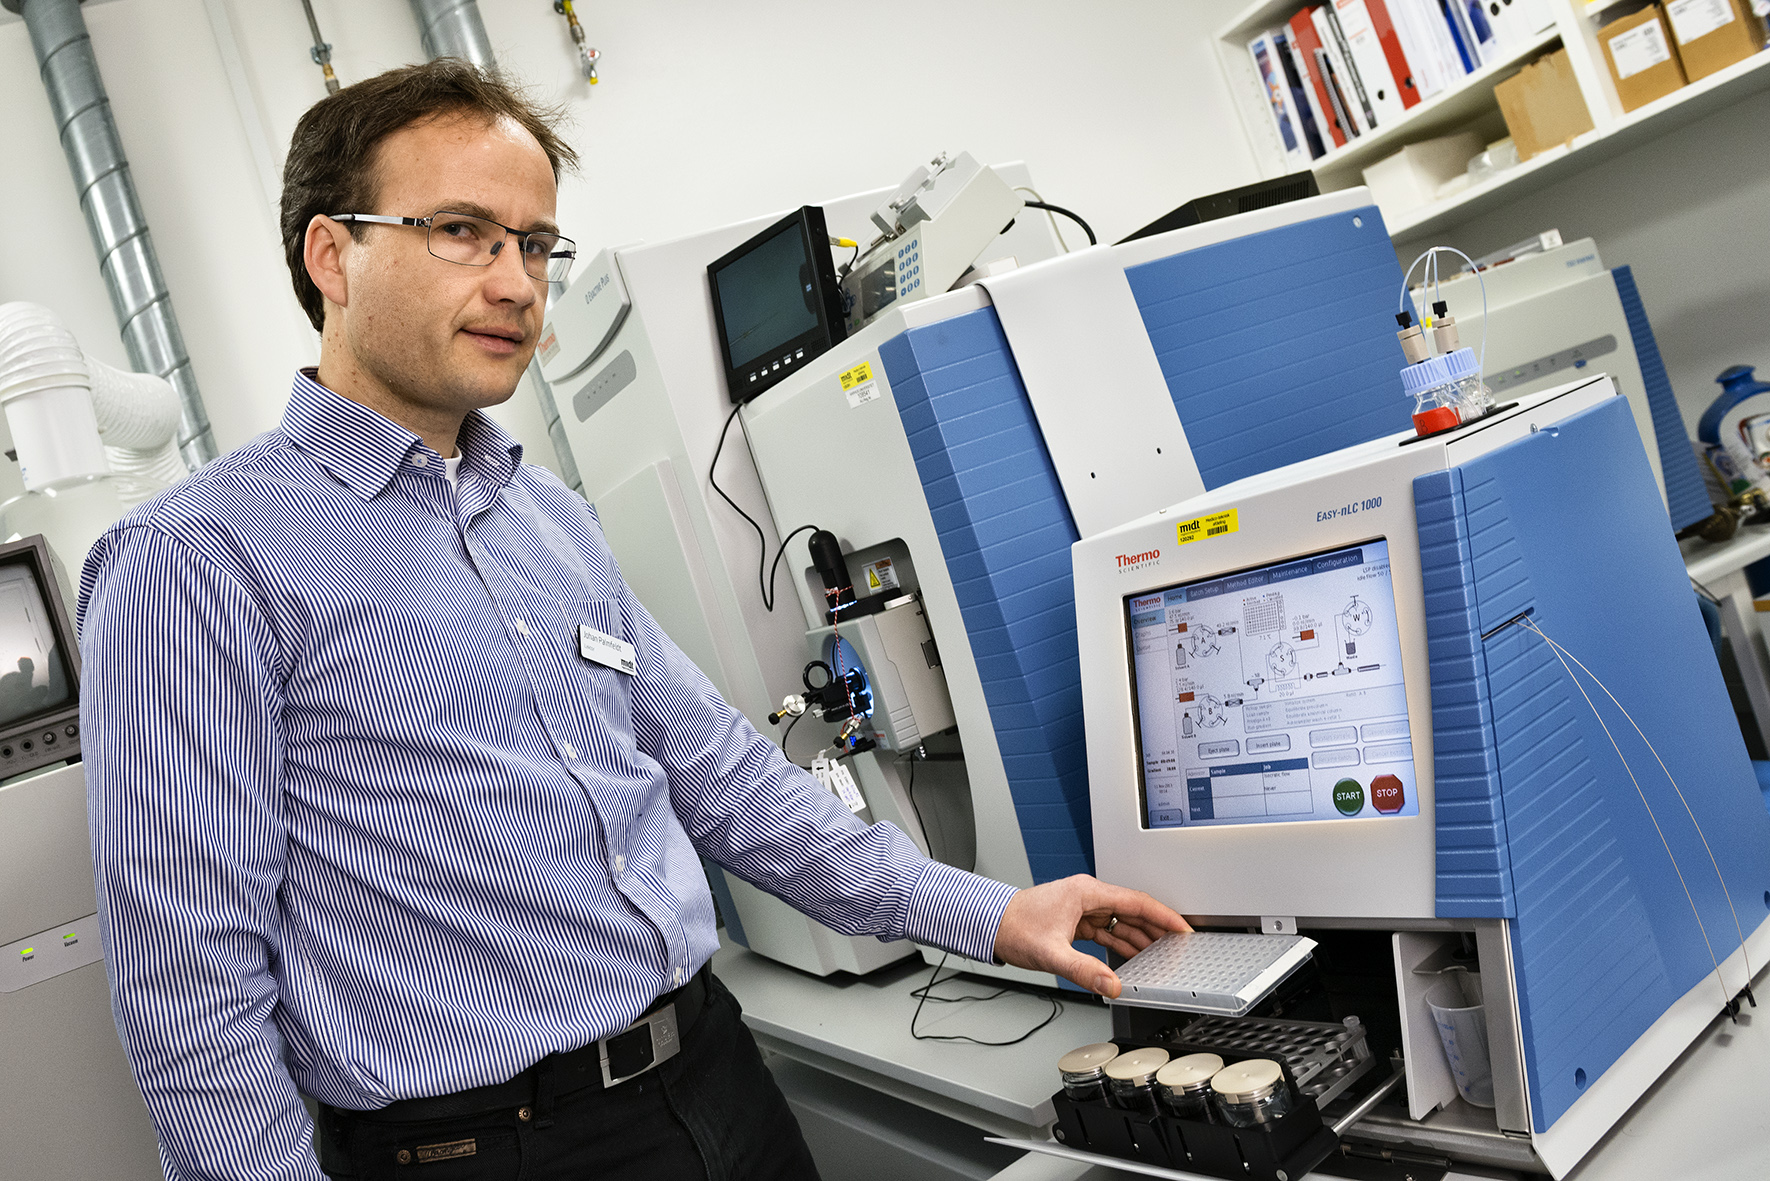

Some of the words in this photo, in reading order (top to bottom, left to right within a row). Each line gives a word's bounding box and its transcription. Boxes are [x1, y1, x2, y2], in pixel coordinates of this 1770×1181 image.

[1419, 419, 1429, 434] B
[1316, 502, 1359, 522] EASY-nLC
[1361, 496, 1382, 511] 1000
[1179, 520, 1200, 533] midt
[1115, 548, 1160, 568] Thermo
[1317, 554, 1358, 571] Configuration
[1118, 560, 1161, 575] SCIENTIFIC
[1273, 565, 1308, 579] Maintenance
[1227, 579, 1246, 590] Method
[1249, 575, 1264, 585] Editor
[1134, 595, 1161, 608] Thermo
[1168, 593, 1182, 602] Home
[1134, 615, 1156, 626] Overview
[1353, 614, 1361, 622] W
[1268, 740, 1281, 749] plate
[1336, 791, 1361, 801] START
[1376, 788, 1398, 797] STOP
[22, 954, 34, 962] Power
